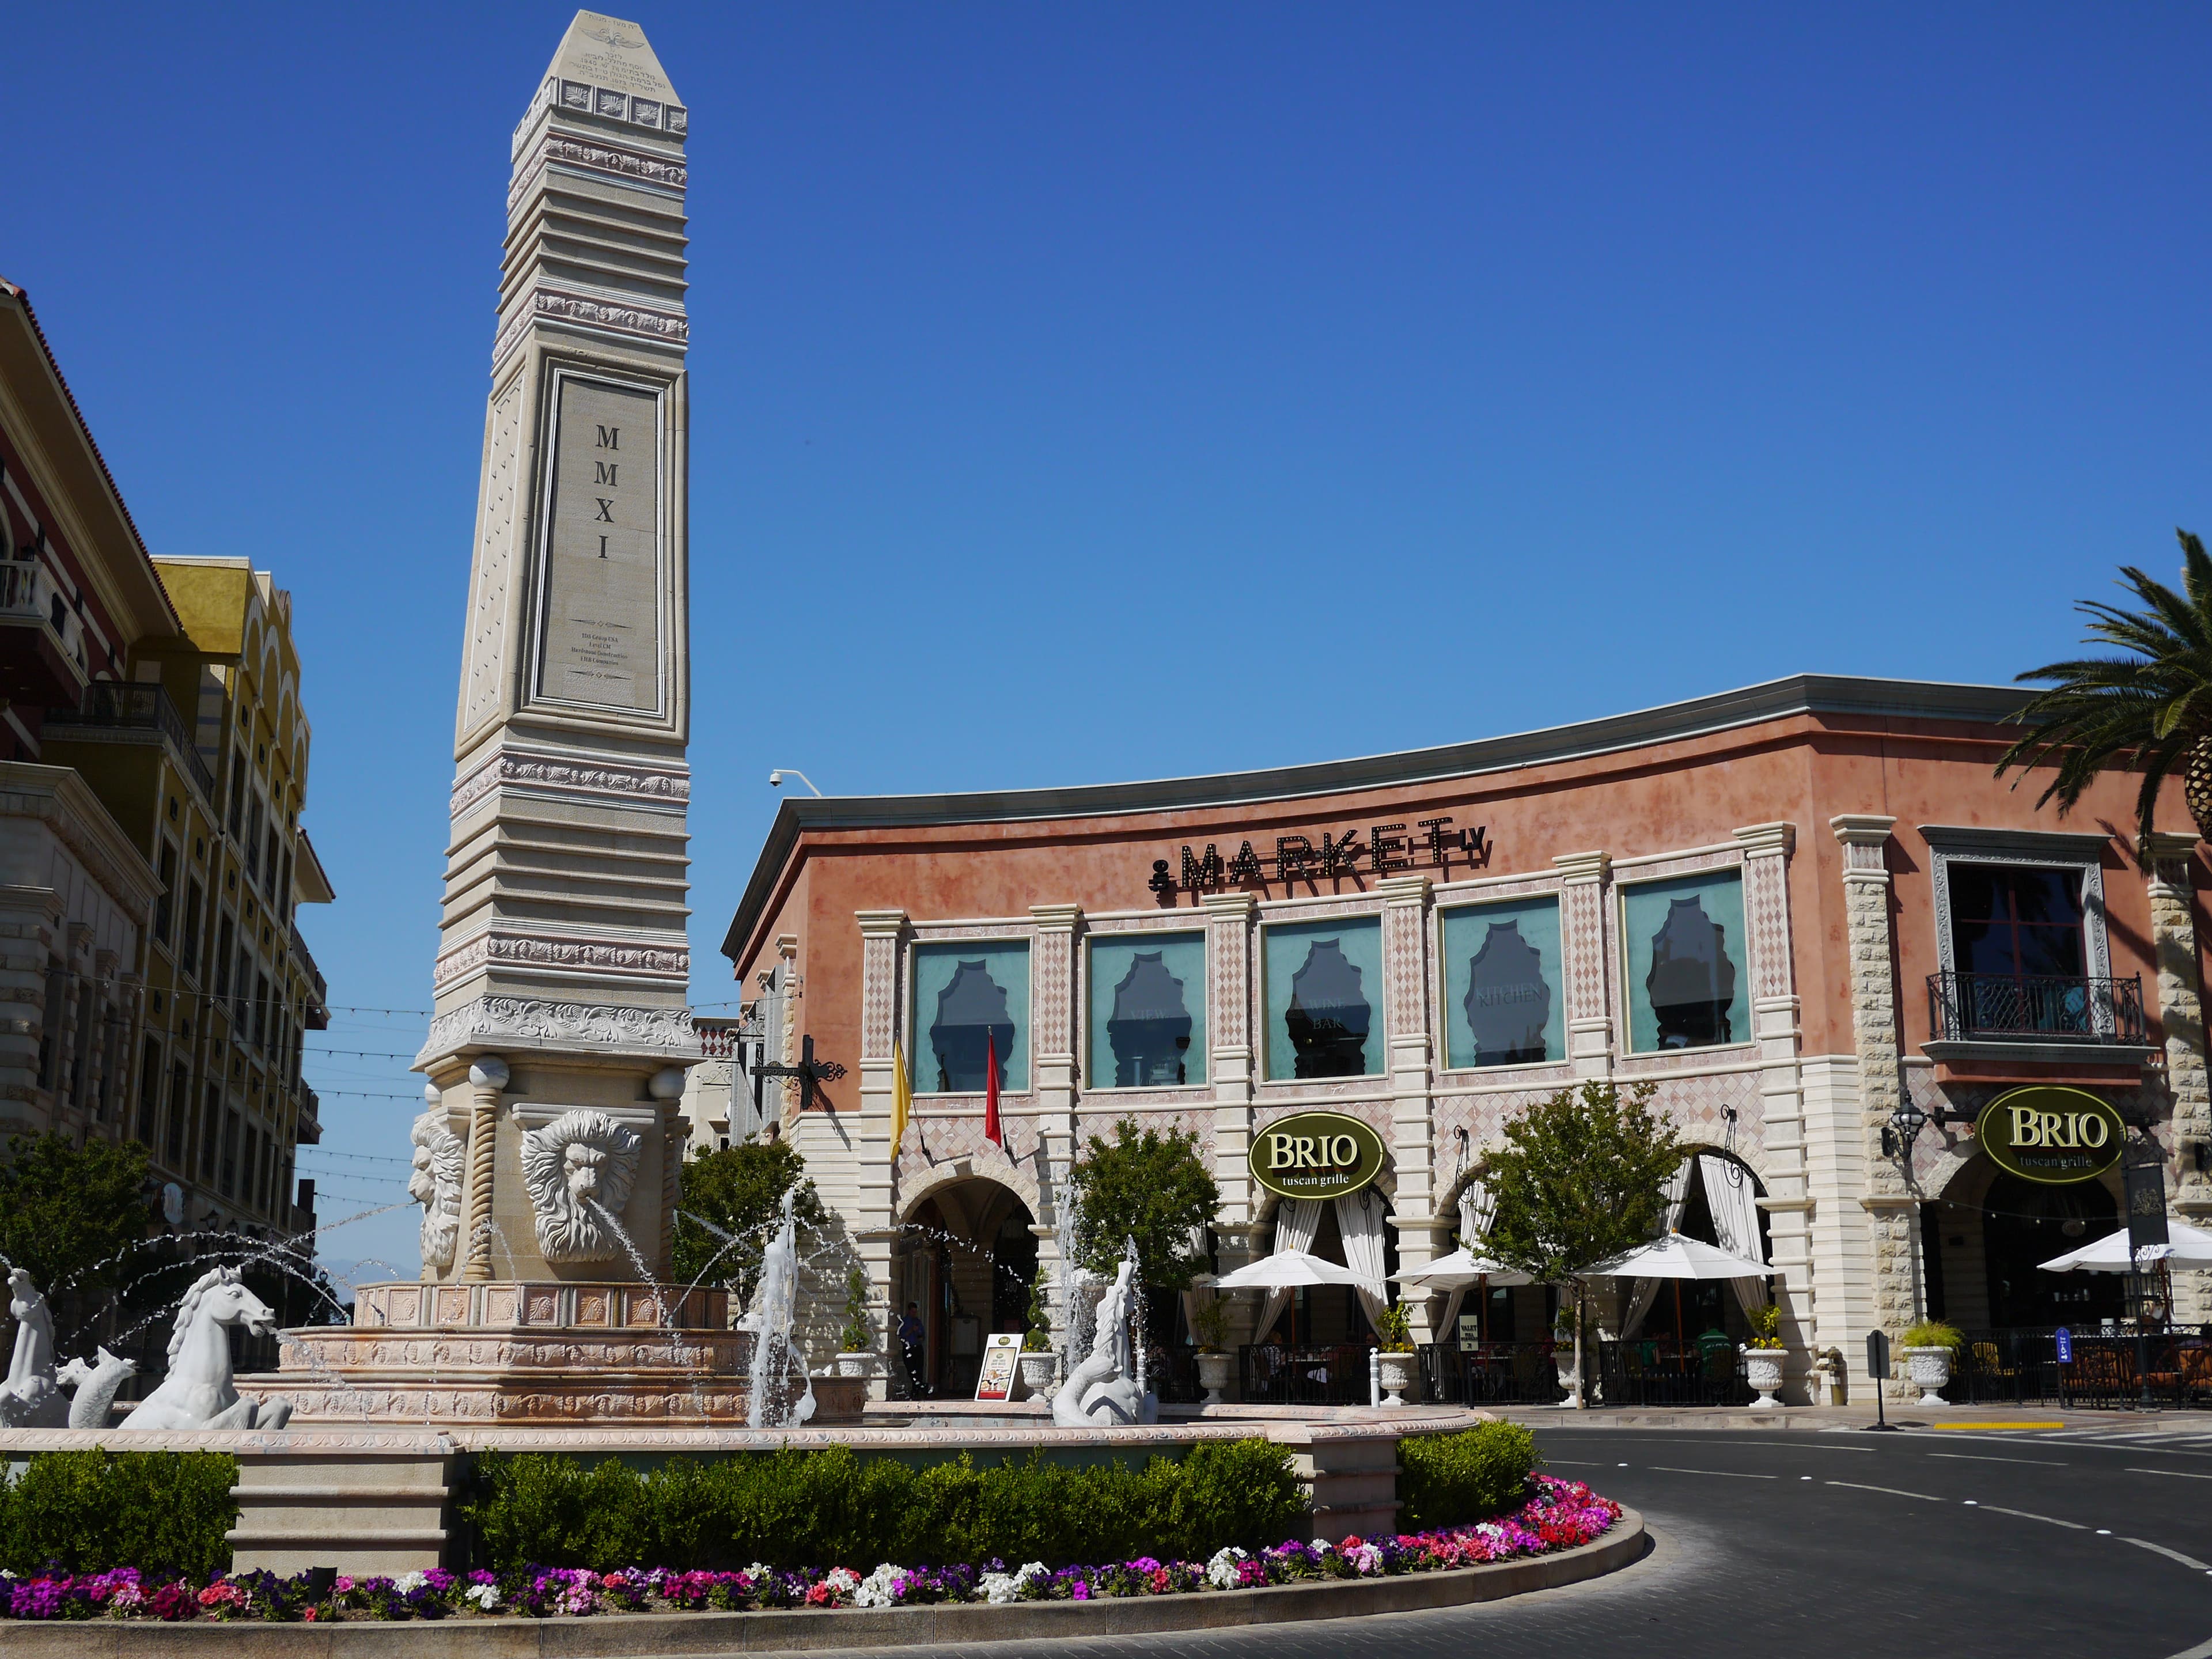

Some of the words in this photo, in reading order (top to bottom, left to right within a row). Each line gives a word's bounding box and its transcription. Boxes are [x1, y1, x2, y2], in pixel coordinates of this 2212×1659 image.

[592, 634, 607, 642] Group
[571, 647, 596, 655] Hardstone
[597, 650, 628, 659] Construction
[1181, 817, 1453, 888] MARKET
[1459, 825, 1486, 852] LV
[1308, 997, 1347, 1011] WINE
[1479, 988, 1543, 1007] KITCHEN
[1312, 1017, 1342, 1030] BAR
[2007, 1105, 2108, 1148] BRIO
[1266, 1133, 1358, 1169] BRIO
[2020, 1157, 2057, 1166] tuscan
[2061, 1155, 2092, 1169] grille
[1283, 1176, 1317, 1186] tuscan
[1320, 1173, 1349, 1187] grille
